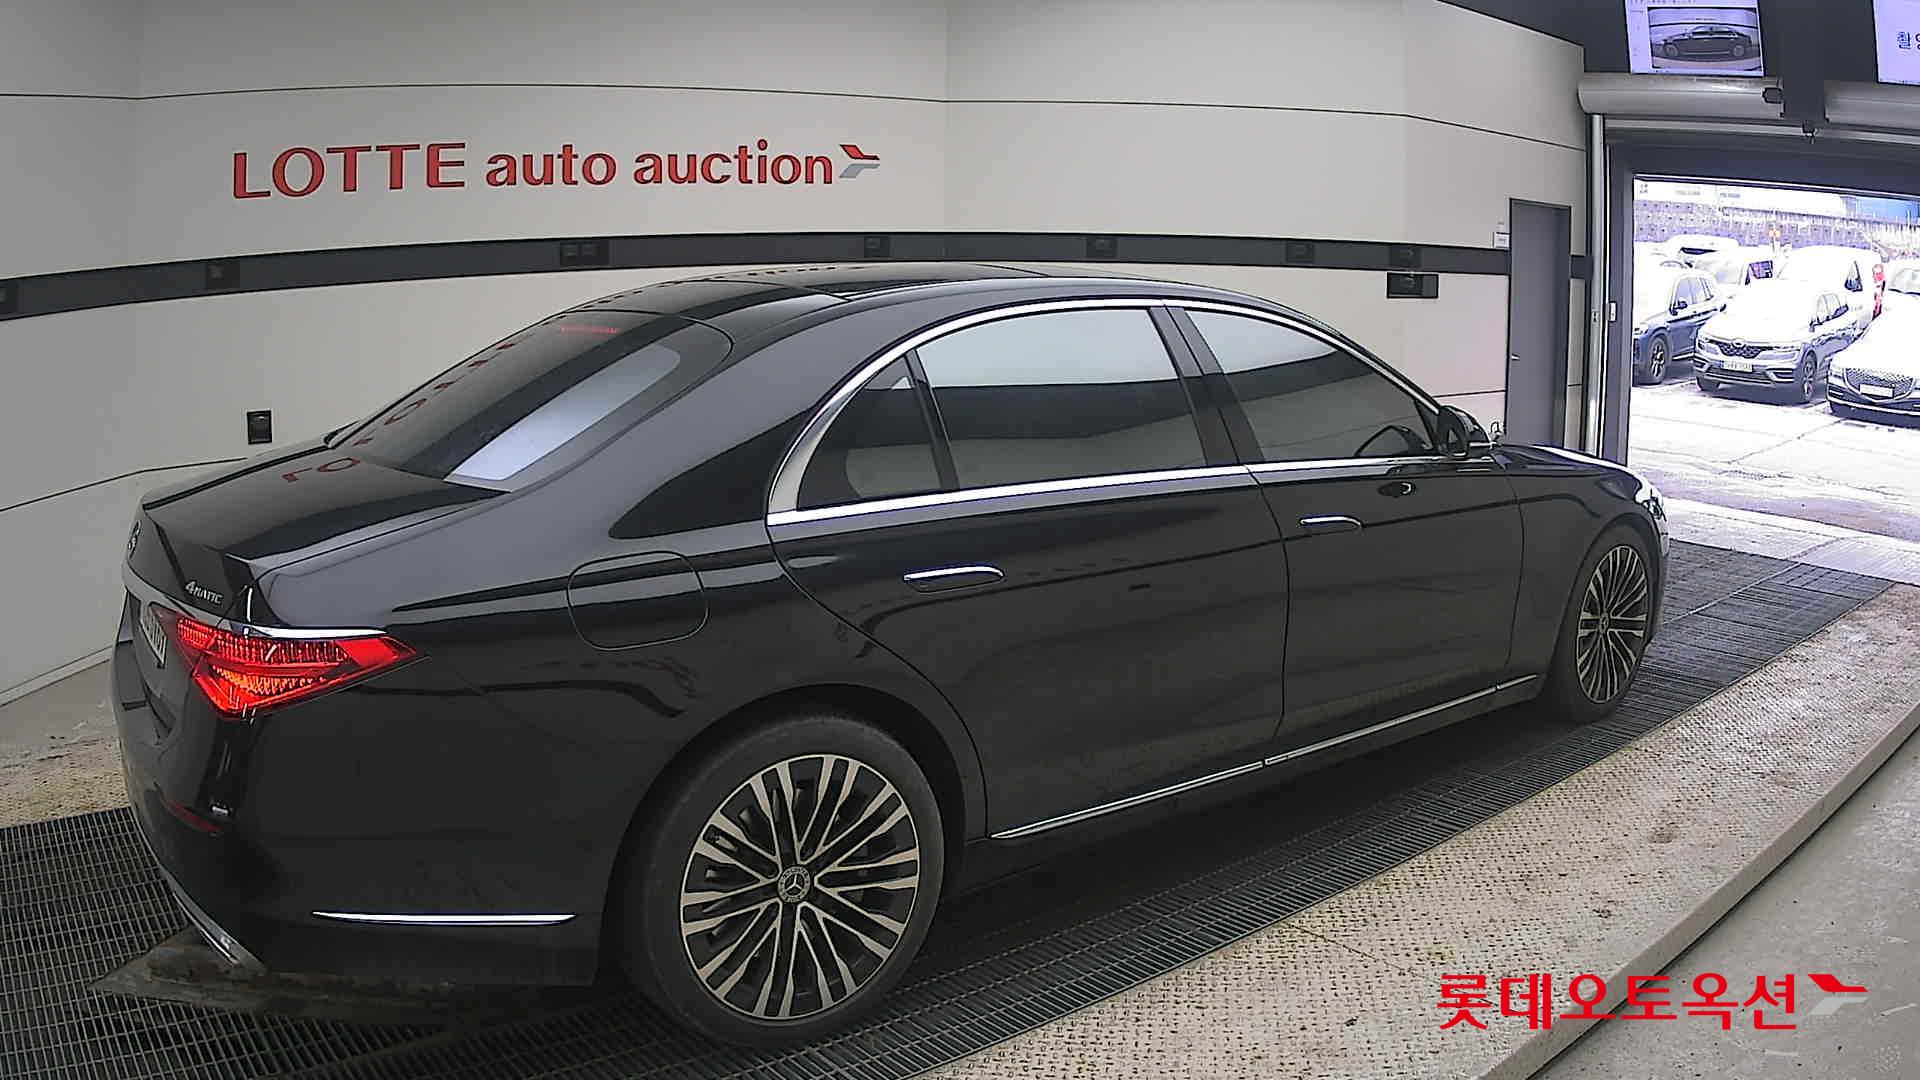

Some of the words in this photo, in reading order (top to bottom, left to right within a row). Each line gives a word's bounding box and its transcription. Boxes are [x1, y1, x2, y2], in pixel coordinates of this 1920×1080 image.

[233, 143, 466, 199] LOTTE
[486, 144, 617, 187] auto
[633, 139, 834, 185] auction
